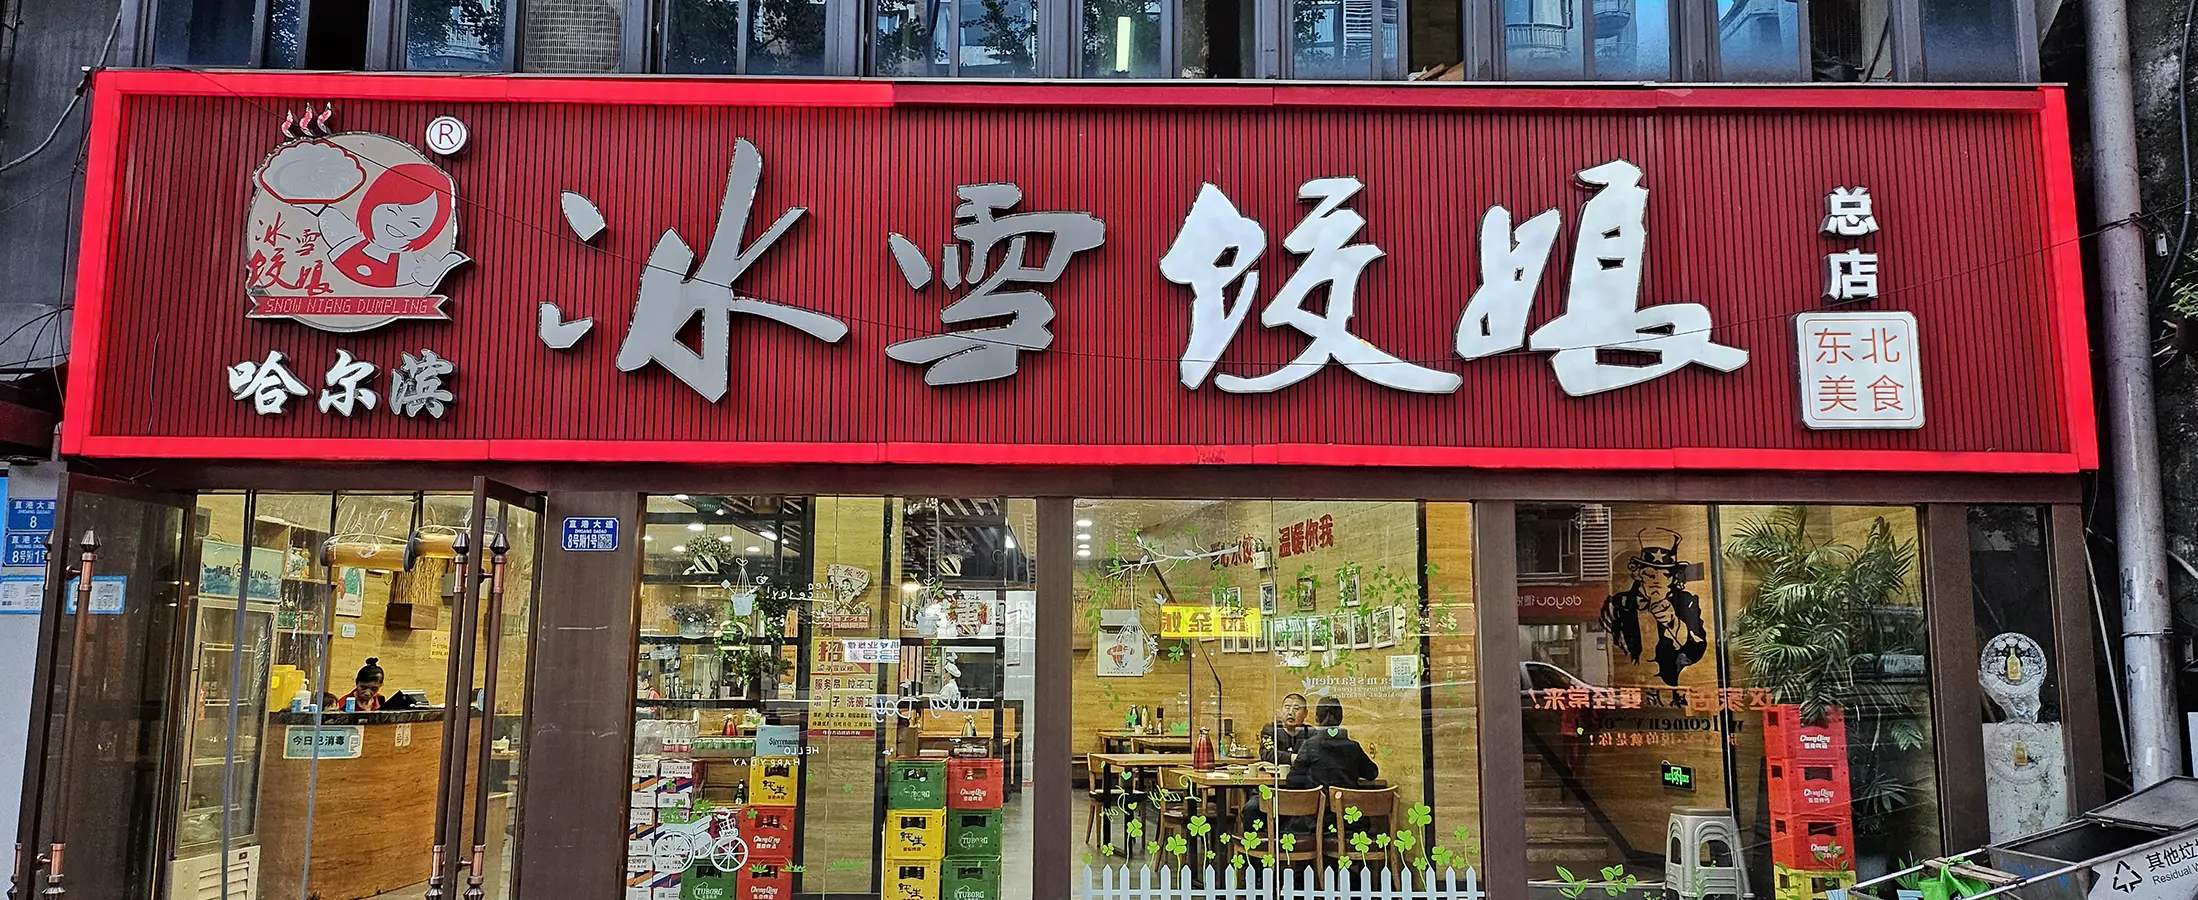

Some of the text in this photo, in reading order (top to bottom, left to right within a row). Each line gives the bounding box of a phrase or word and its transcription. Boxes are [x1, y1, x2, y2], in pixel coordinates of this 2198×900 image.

[255, 212, 321, 257] 冰雪
[1819, 185, 1880, 300] 总店
[249, 249, 334, 296] 饺娘
[538, 137, 1750, 403] 冰雪饺娘
[265, 298, 428, 314] SNOW NIANG DUMPLING
[1814, 327, 1900, 364] 东北
[228, 350, 455, 418] 哈尔滨
[1818, 375, 1904, 412] 美食
[14, 501, 56, 510] 直港大道
[29, 515, 37, 529] 8
[568, 519, 614, 529] 直港大道
[11, 535, 46, 545] 直港大
[567, 533, 598, 549] 8号附1号
[1278, 513, 1333, 558] 温暖你我
[814, 678, 873, 690] 服务员 饺子工
[846, 694, 873, 708] 洗碗工
[2145, 838, 2198, 873] 其他垃
[2152, 865, 2193, 886] Residual
[697, 886, 723, 897] TUBORG
[958, 889, 984, 899] TUBORG
